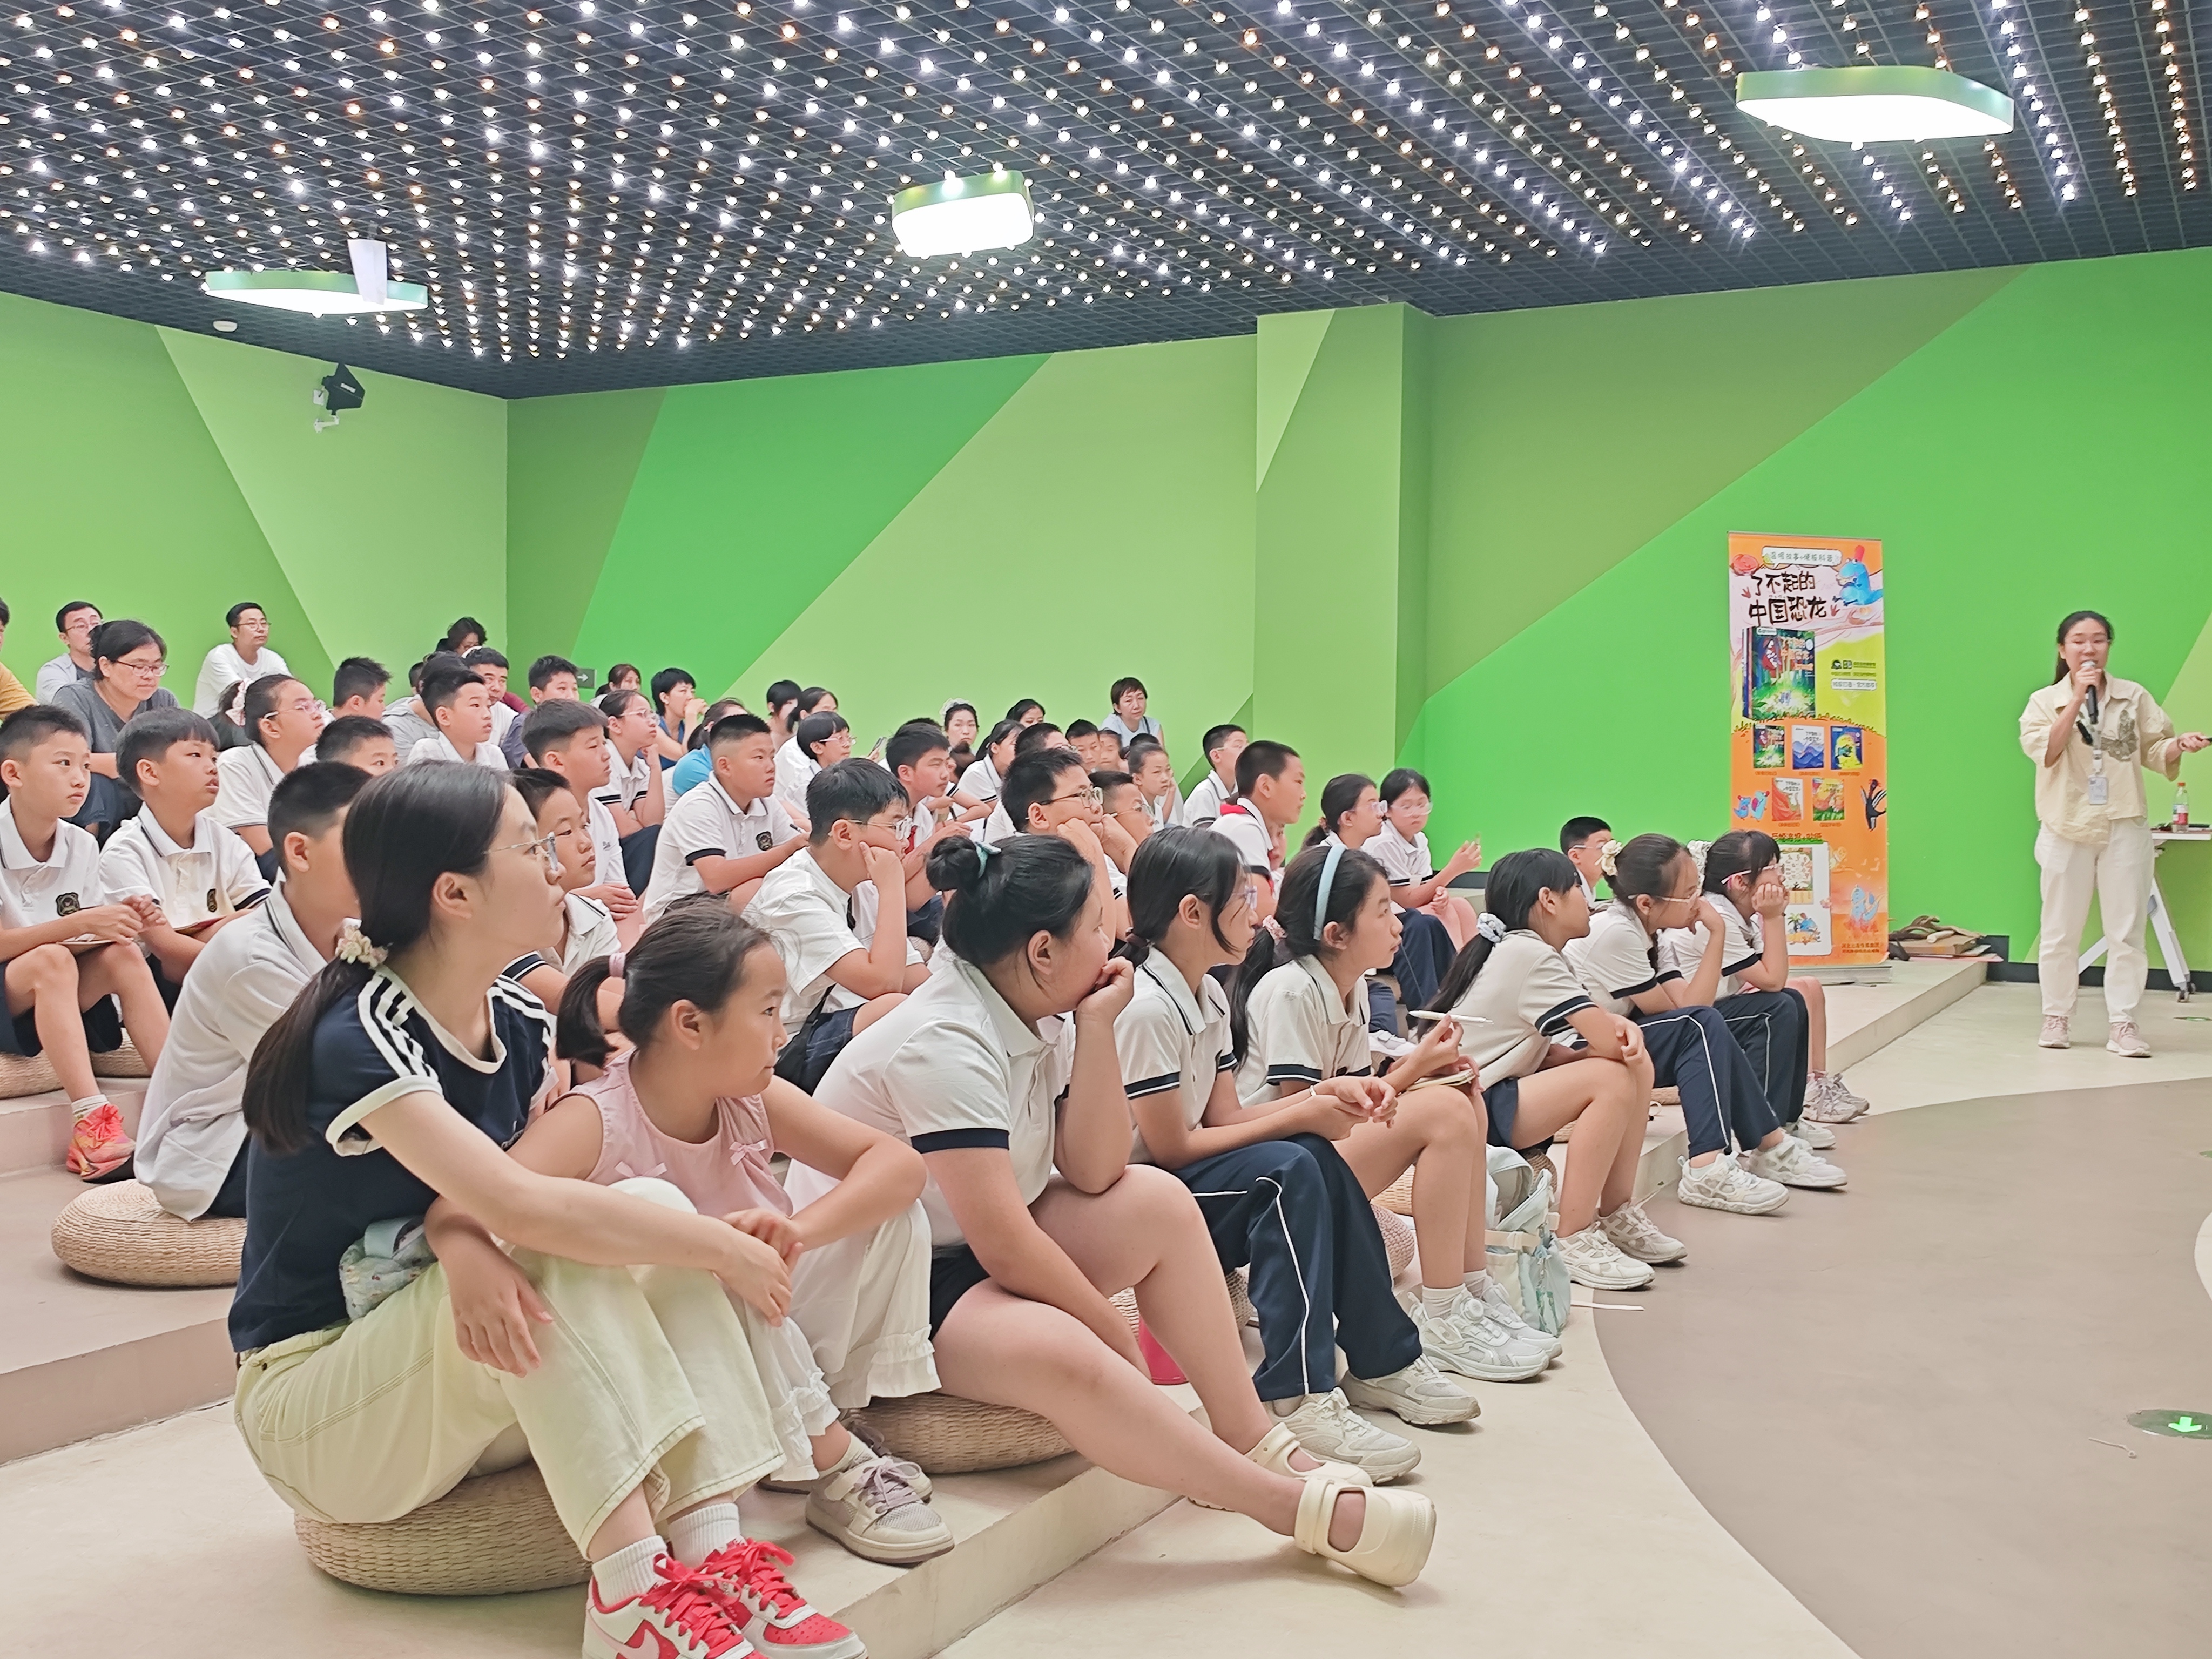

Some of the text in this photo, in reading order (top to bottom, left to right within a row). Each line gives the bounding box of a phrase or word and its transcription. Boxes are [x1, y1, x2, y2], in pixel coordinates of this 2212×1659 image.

[1751, 571, 1816, 596] 了不起的
[1749, 596, 1827, 626] 中国恐龙
